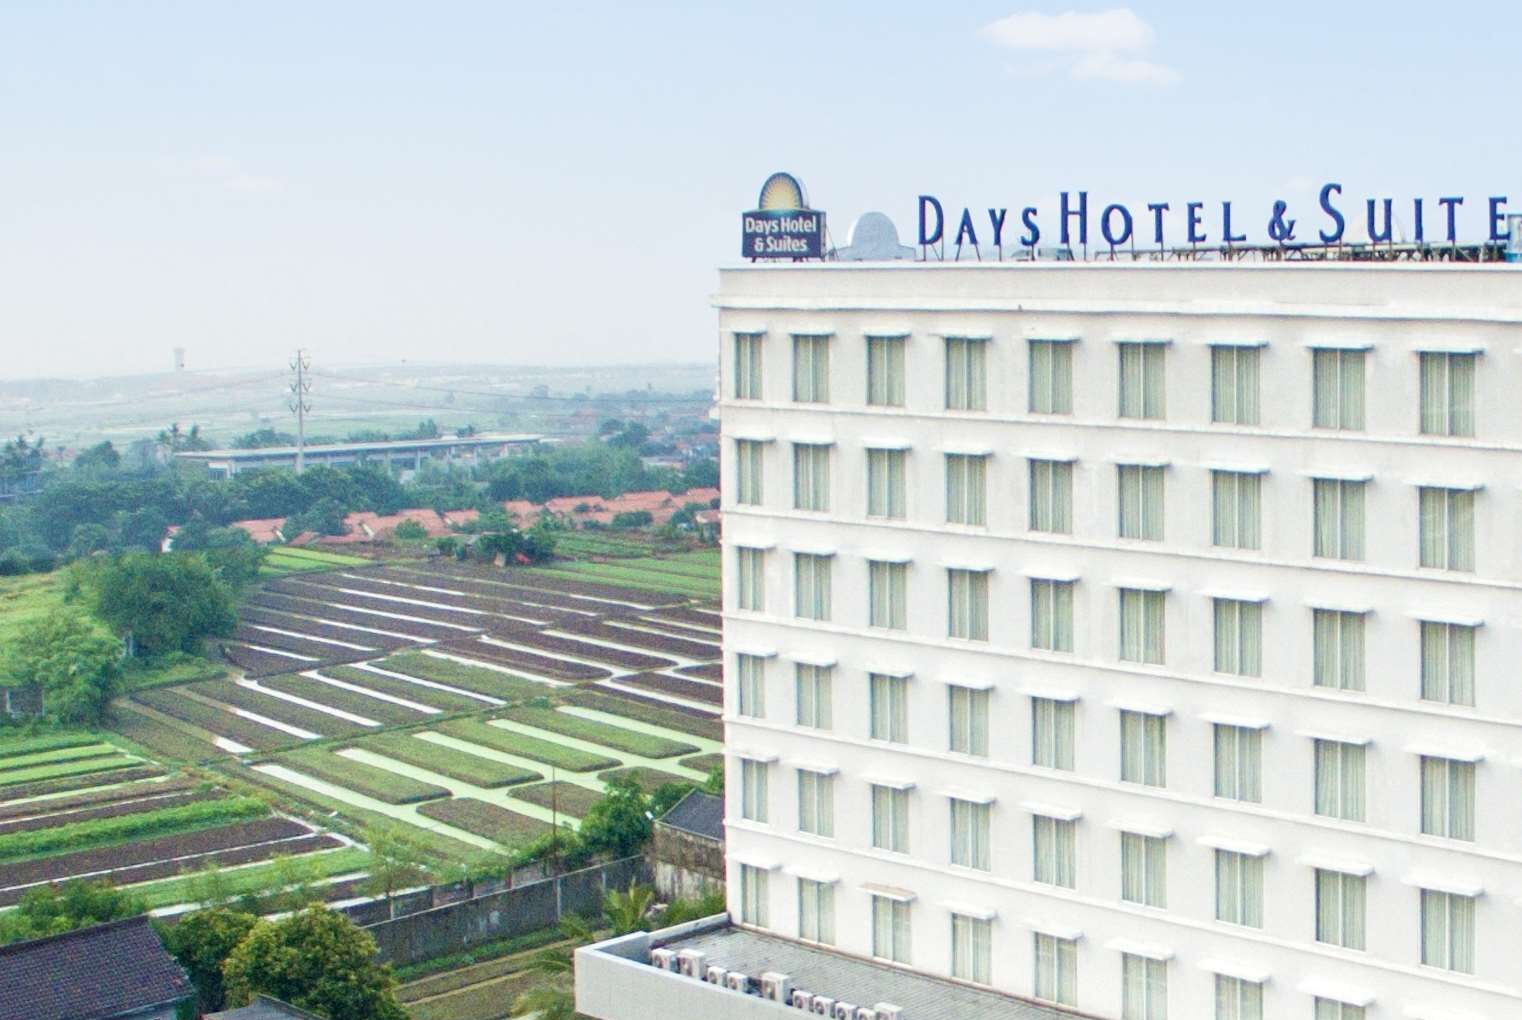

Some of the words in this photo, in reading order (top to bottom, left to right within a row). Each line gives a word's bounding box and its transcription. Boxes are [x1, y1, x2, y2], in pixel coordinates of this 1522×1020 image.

[745, 217, 779, 235] Days
[780, 215, 817, 233] Hotel
[918, 195, 1040, 246] DAYS
[1060, 191, 1246, 245] HOTEL
[1267, 200, 1296, 241] &
[754, 236, 764, 252] &
[766, 235, 808, 252] Suites
